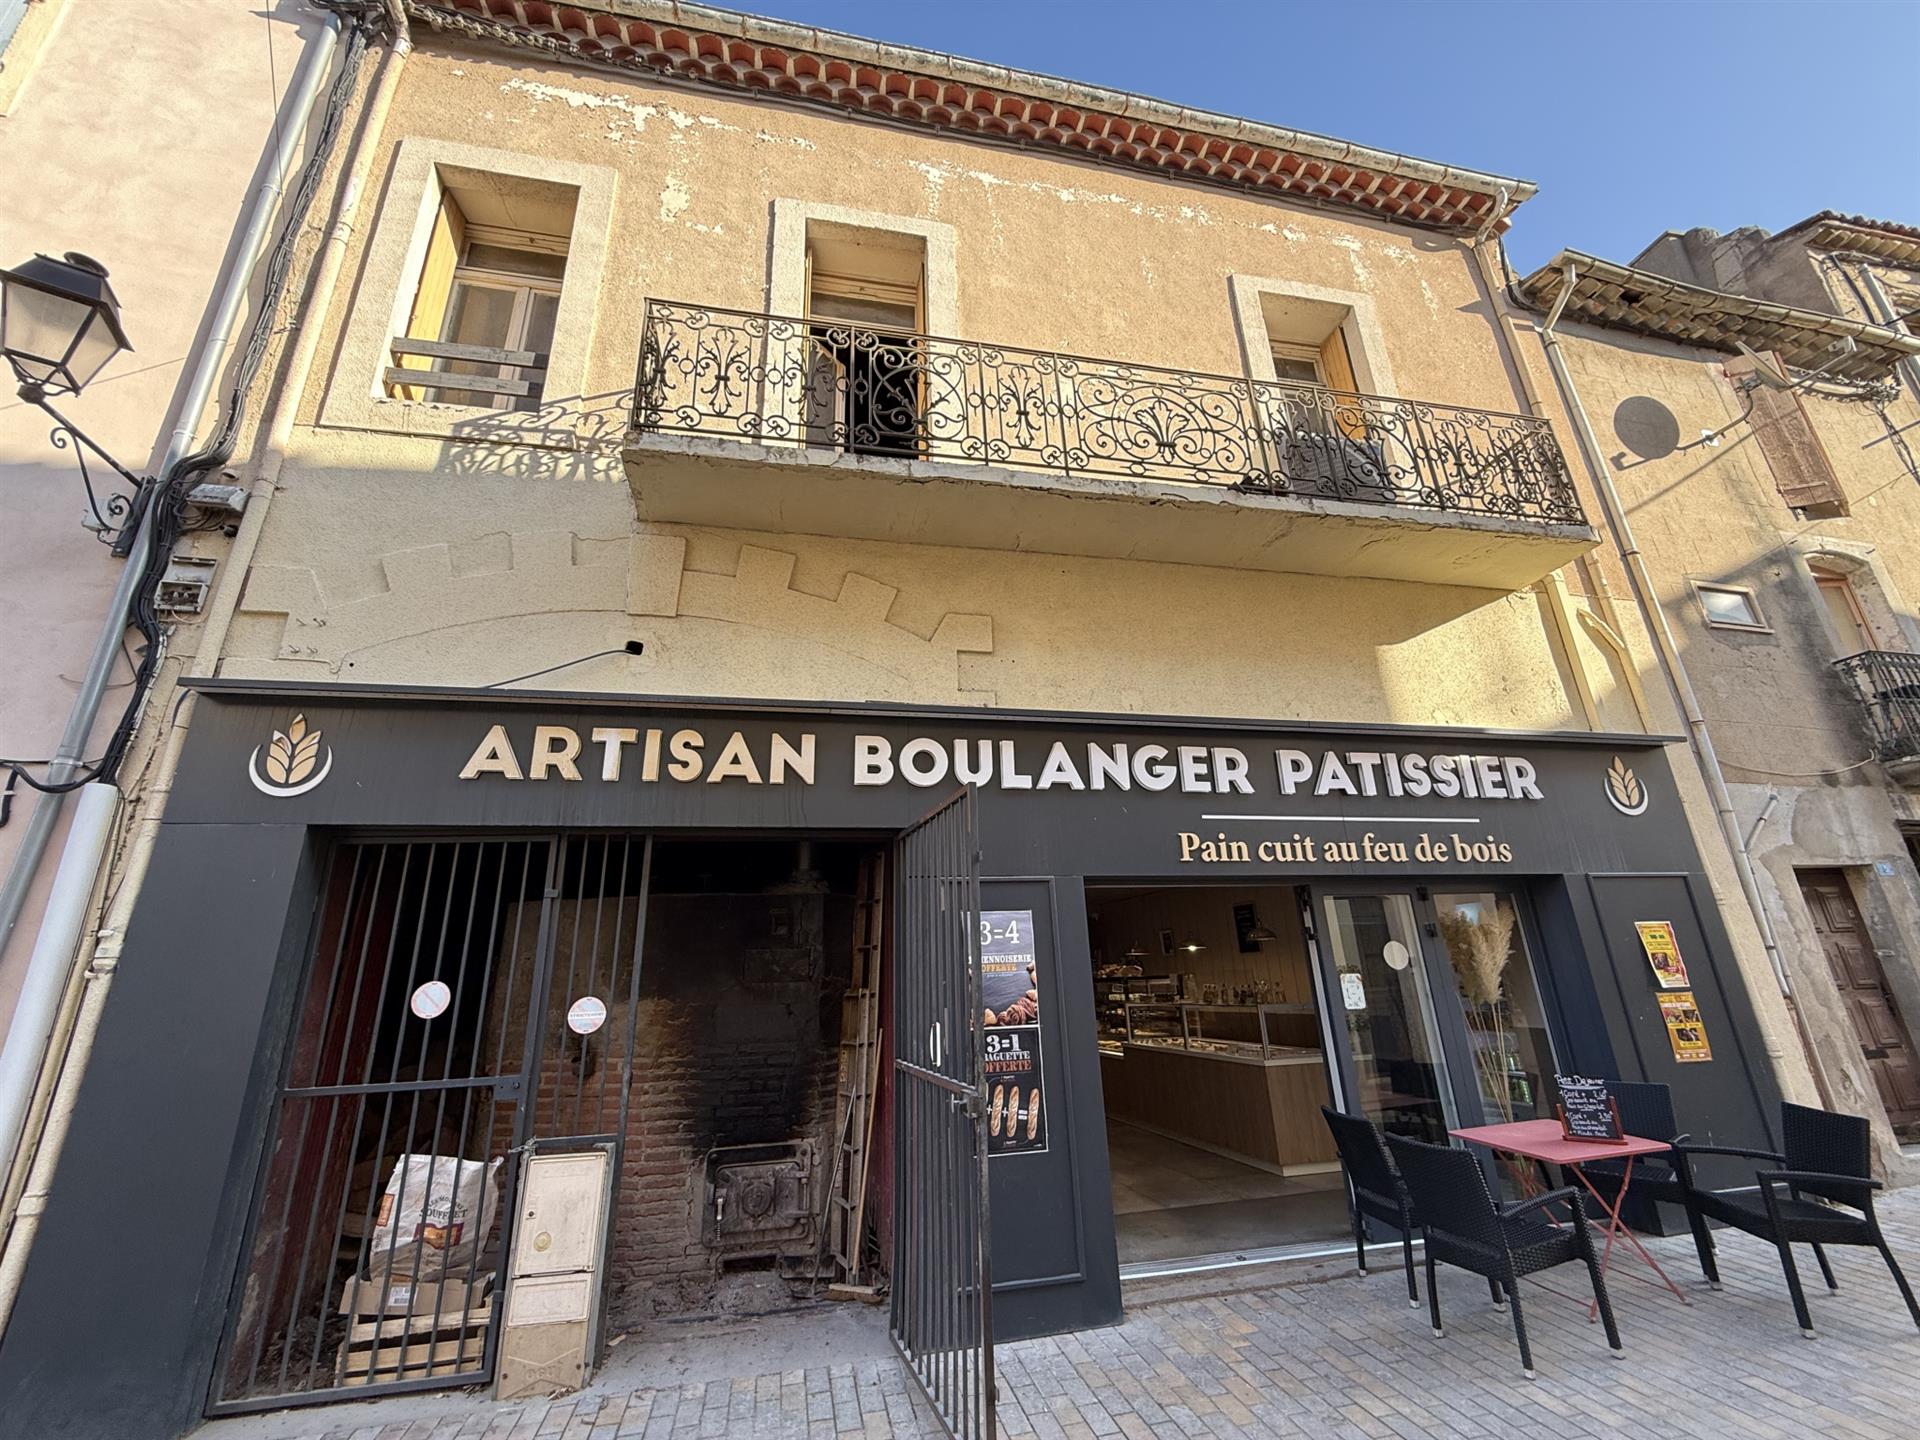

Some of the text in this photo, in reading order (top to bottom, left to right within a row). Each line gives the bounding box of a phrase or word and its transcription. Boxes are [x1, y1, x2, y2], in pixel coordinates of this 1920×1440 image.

[458, 724, 1545, 800] ARTISAN BOULANGER PATISSIER
[1178, 832, 1513, 864] Pain cuit au feu de bois
[986, 1034, 1021, 1053] 3=1
[419, 1208, 468, 1219] OUFFET
